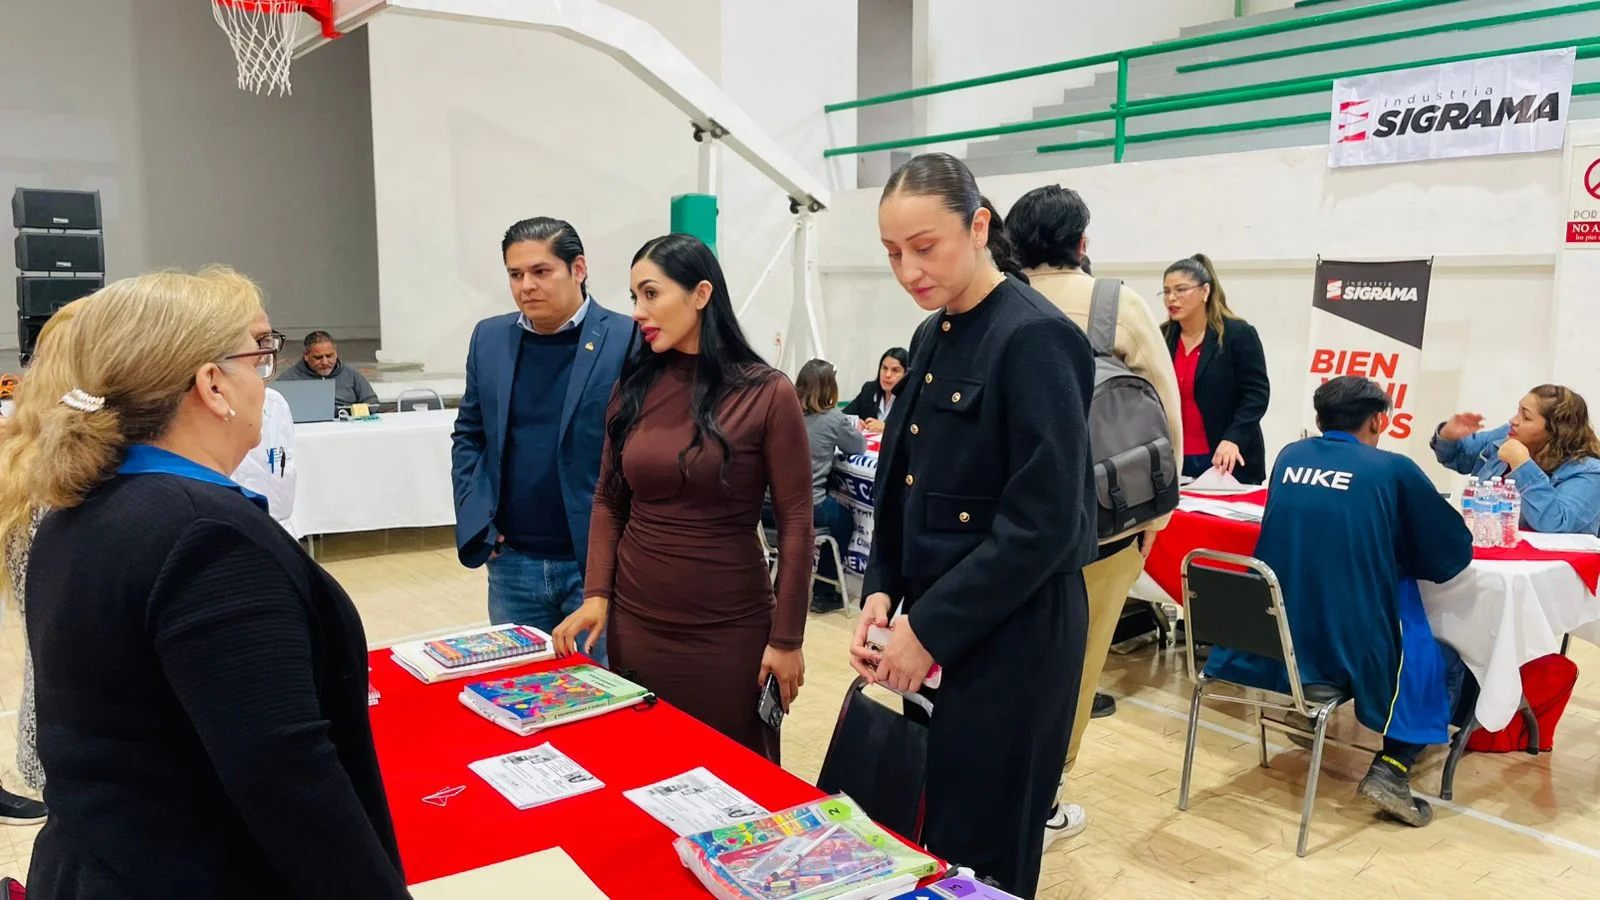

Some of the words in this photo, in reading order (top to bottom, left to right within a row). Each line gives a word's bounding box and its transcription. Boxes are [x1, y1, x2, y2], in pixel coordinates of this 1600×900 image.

[1384, 86, 1493, 107] industria
[1373, 92, 1559, 138] SIGRAMA
[1573, 210, 1597, 219] POR
[1572, 223, 1590, 233] NO
[1591, 223, 1600, 233] A
[1342, 286, 1418, 301] SIGRAMA
[1310, 349, 1399, 379] BIEN
[1282, 466, 1353, 491] NIKE
[828, 807, 841, 816] 2
